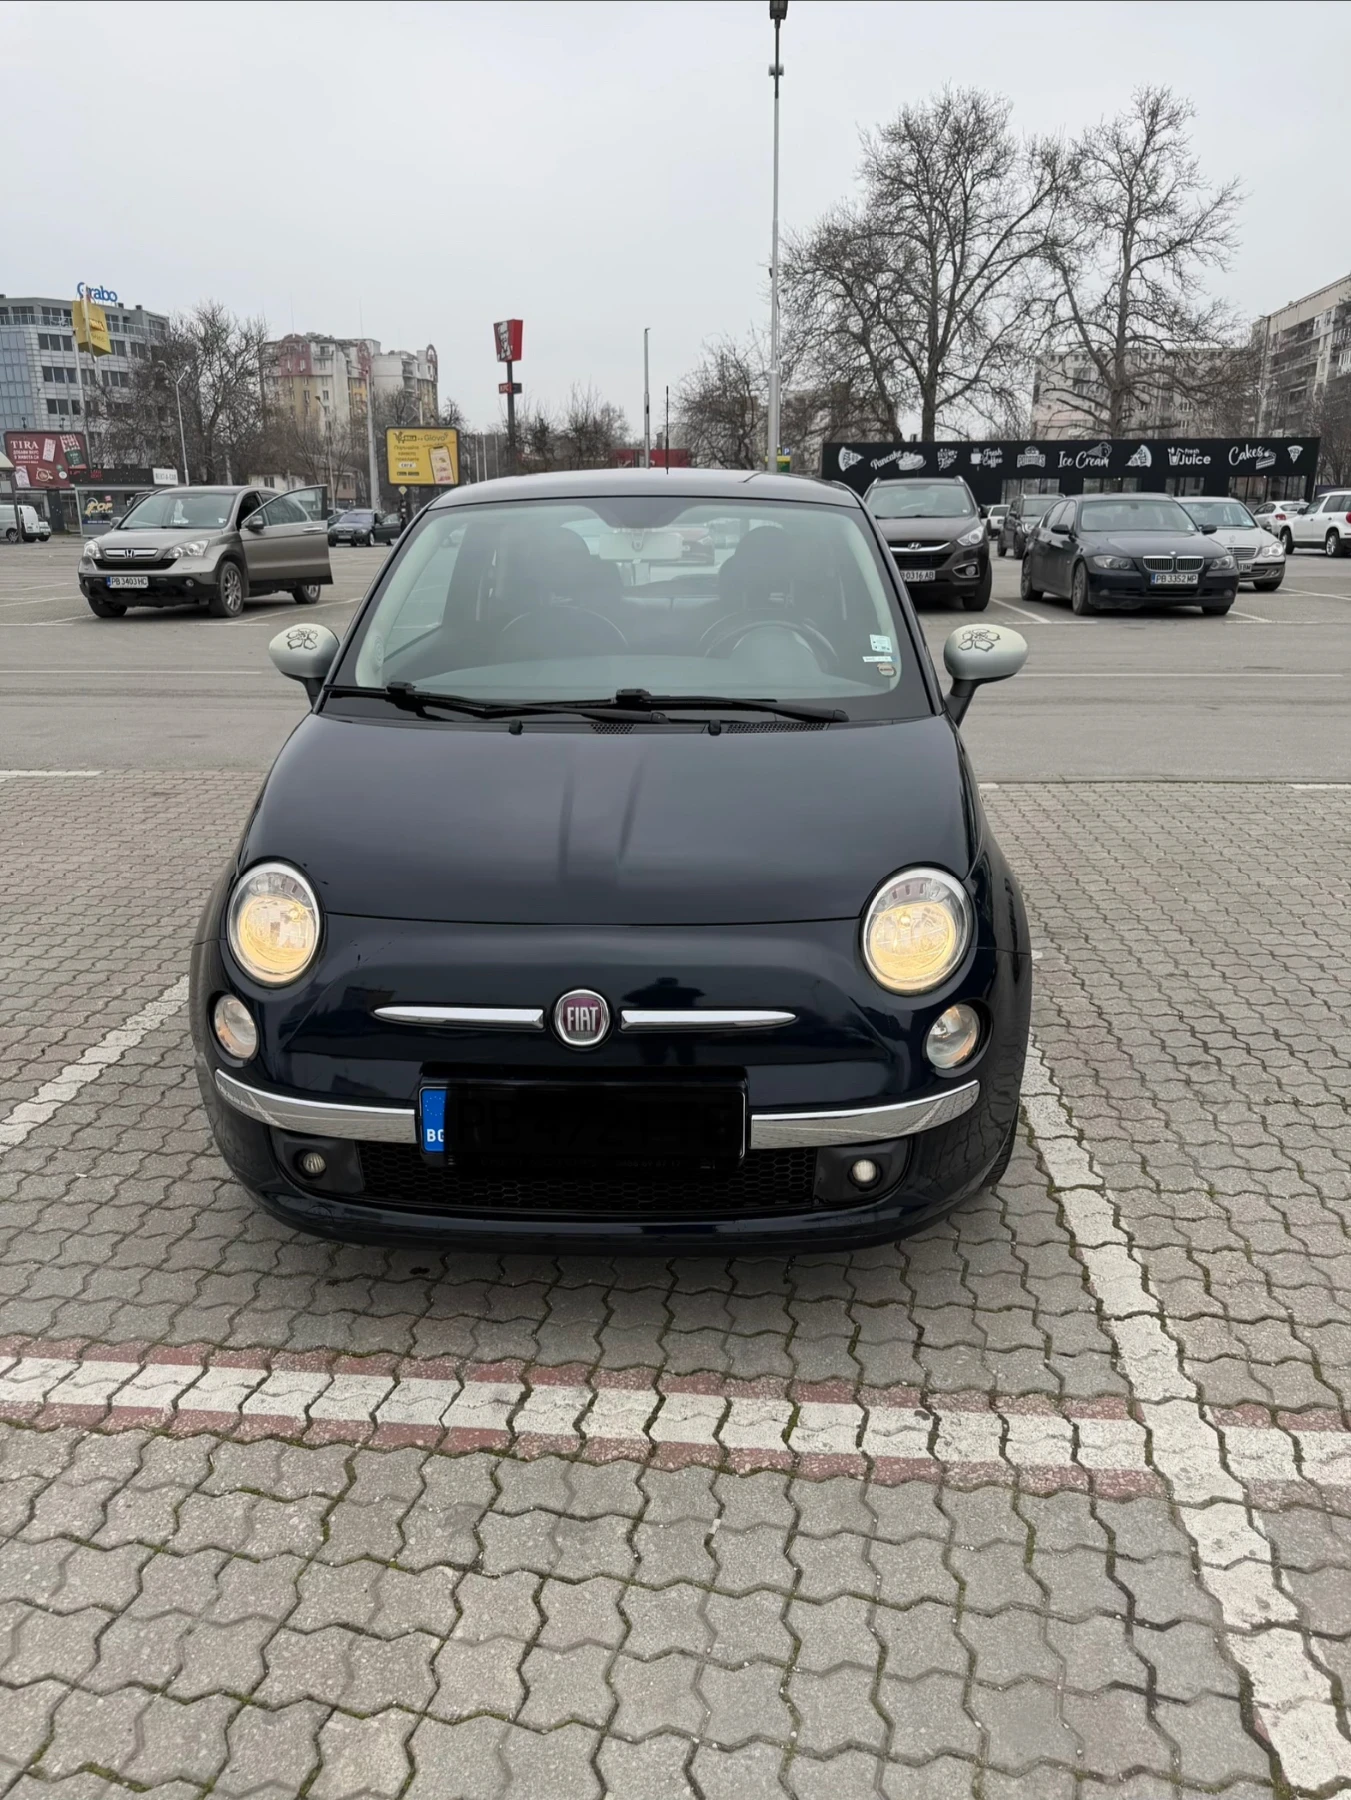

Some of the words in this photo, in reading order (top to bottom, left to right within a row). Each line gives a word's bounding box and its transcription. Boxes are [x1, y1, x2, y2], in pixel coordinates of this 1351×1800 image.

[10, 440, 39, 450] TIRA
[424, 434, 446, 442] Glovo
[1058, 451, 1075, 468] Ice
[1075, 450, 1110, 469] Cream
[1179, 455, 1212, 465] Juice
[1228, 444, 1264, 466] Cakes
[982, 456, 1003, 469] Coffee
[566, 1005, 600, 1032] FIAT
[426, 1128, 445, 1143] BG
